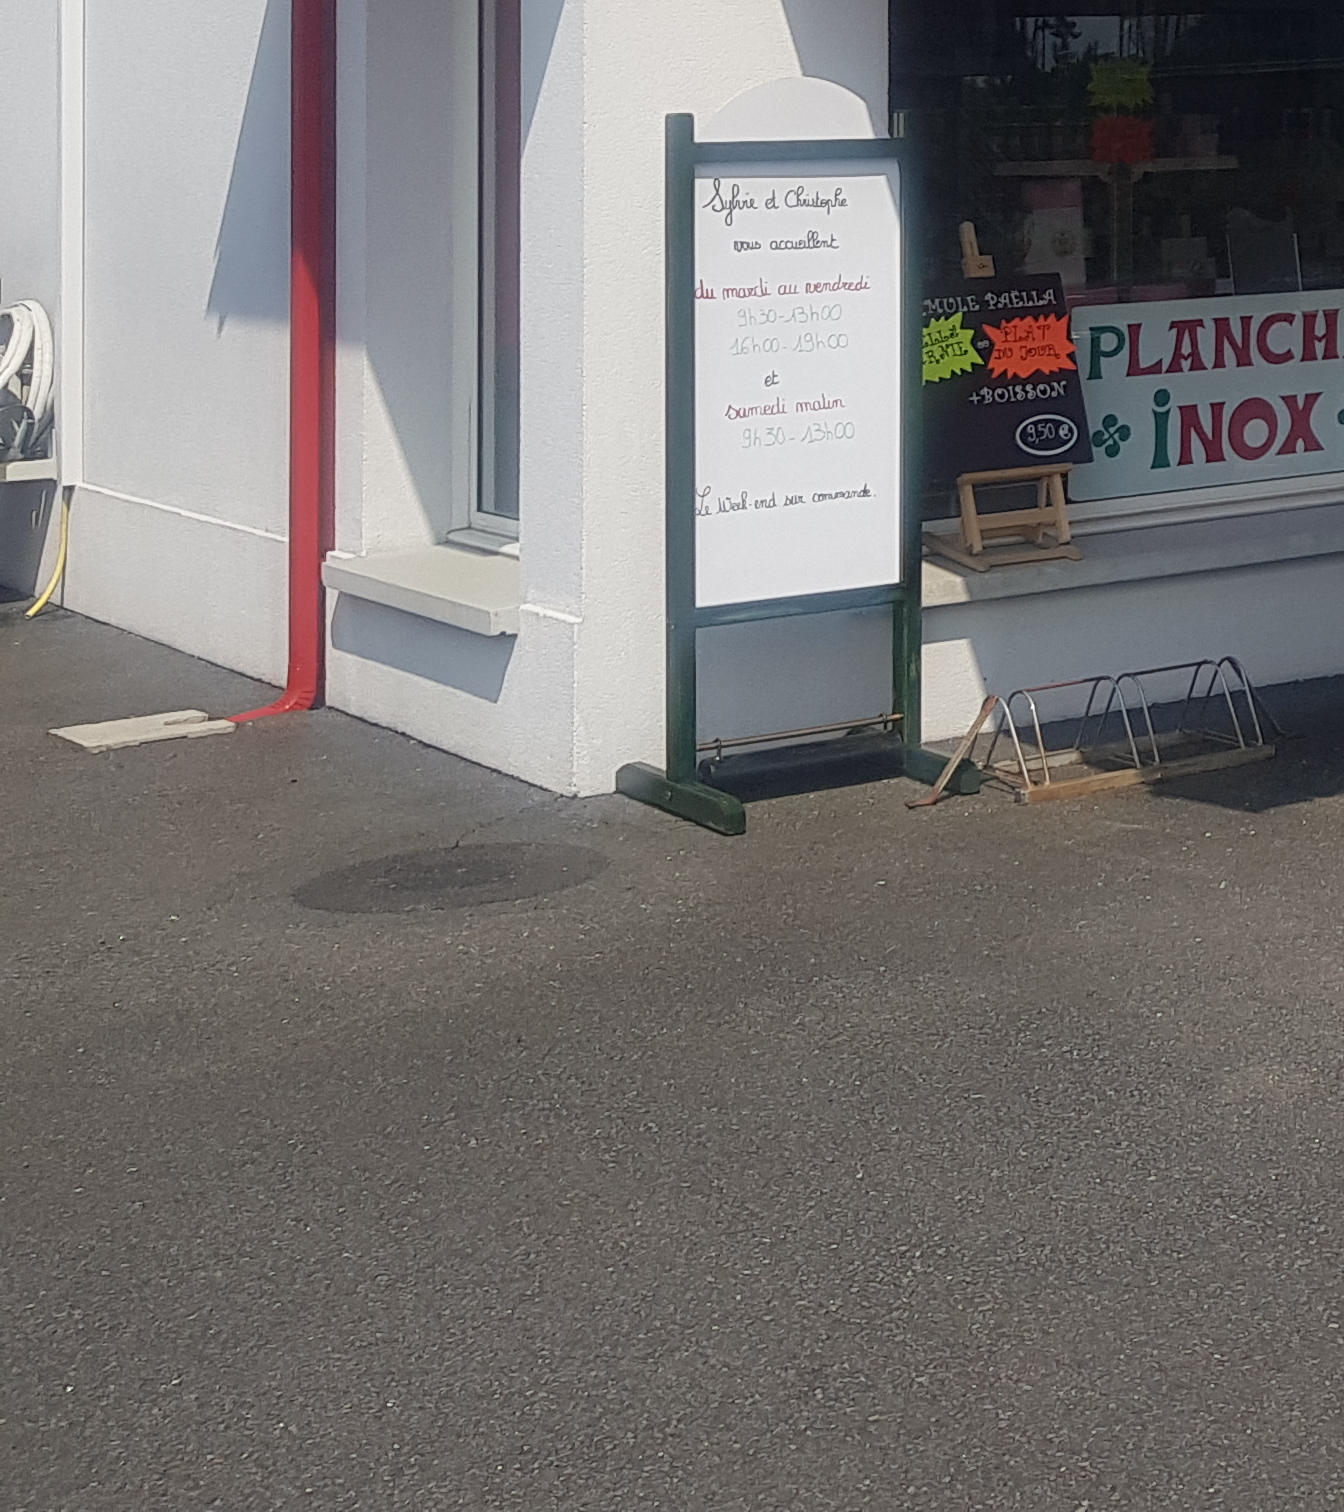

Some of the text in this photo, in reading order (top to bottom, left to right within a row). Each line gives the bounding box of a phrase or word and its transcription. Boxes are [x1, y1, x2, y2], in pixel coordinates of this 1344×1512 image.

[702, 178, 848, 226] Sylvie et Christophe
[734, 230, 840, 252] vous accueillent
[694, 274, 871, 300] du mardi au vendredi
[923, 289, 1057, 316] MULE PAËLLA
[1001, 323, 1051, 343] PLAT
[923, 341, 969, 364] RNIE
[994, 343, 1061, 361] DU JOUR
[765, 370, 780, 387] et
[725, 393, 846, 420] samedi matin
[693, 485, 713, 516] Le
[783, 495, 806, 507] sur
